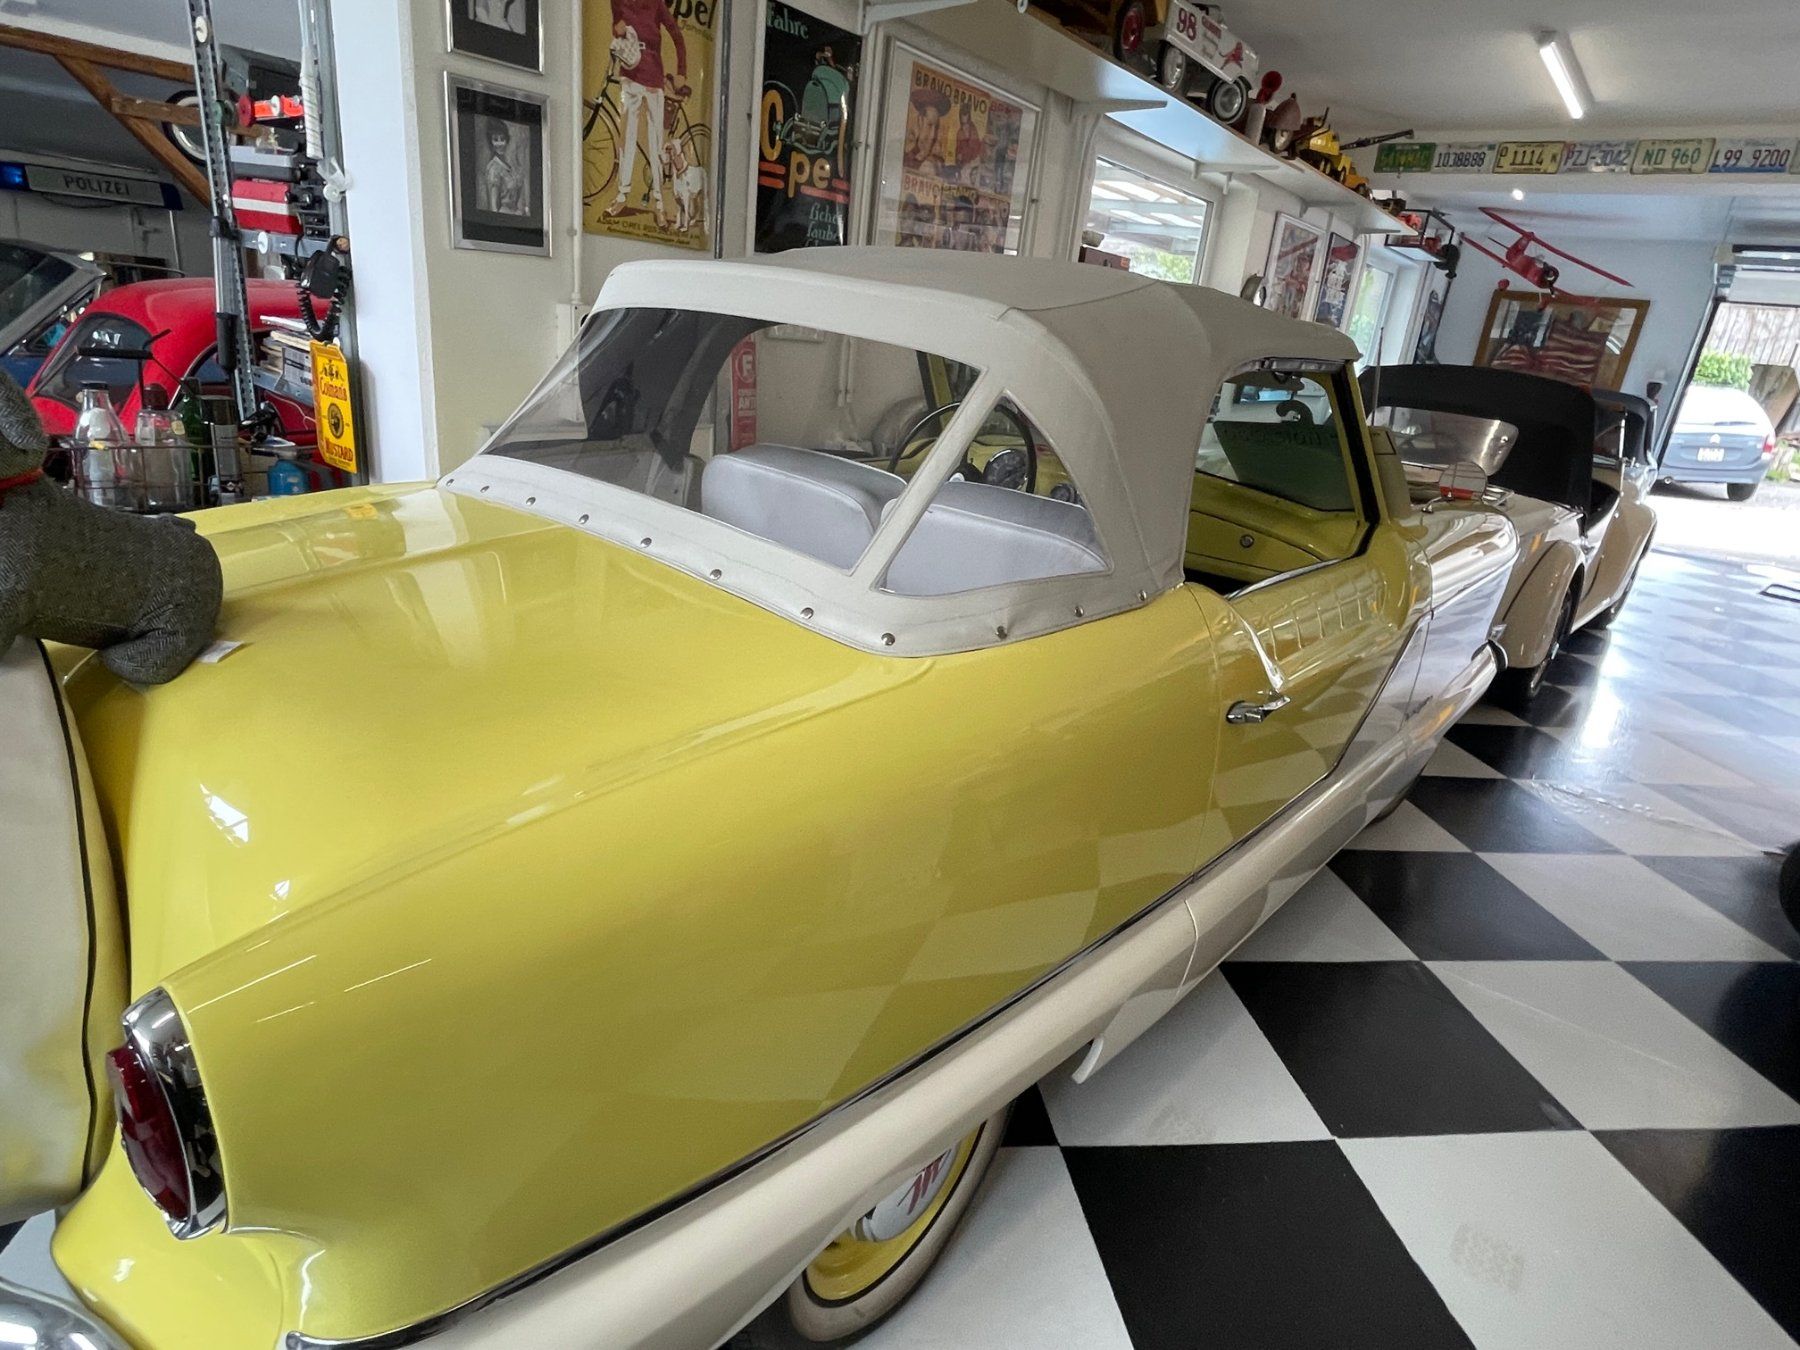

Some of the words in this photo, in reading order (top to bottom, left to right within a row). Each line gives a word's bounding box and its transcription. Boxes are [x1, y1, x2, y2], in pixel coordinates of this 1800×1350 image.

[664, 0, 718, 29] pel
[1176, 7, 1197, 42] 98
[914, 69, 952, 98] BRAVO
[1671, 147, 1701, 171] 960
[1710, 149, 1743, 168] L99
[1750, 148, 1791, 168] 9200
[62, 173, 131, 196] POLIZEI
[324, 436, 354, 463] MUSTARD
